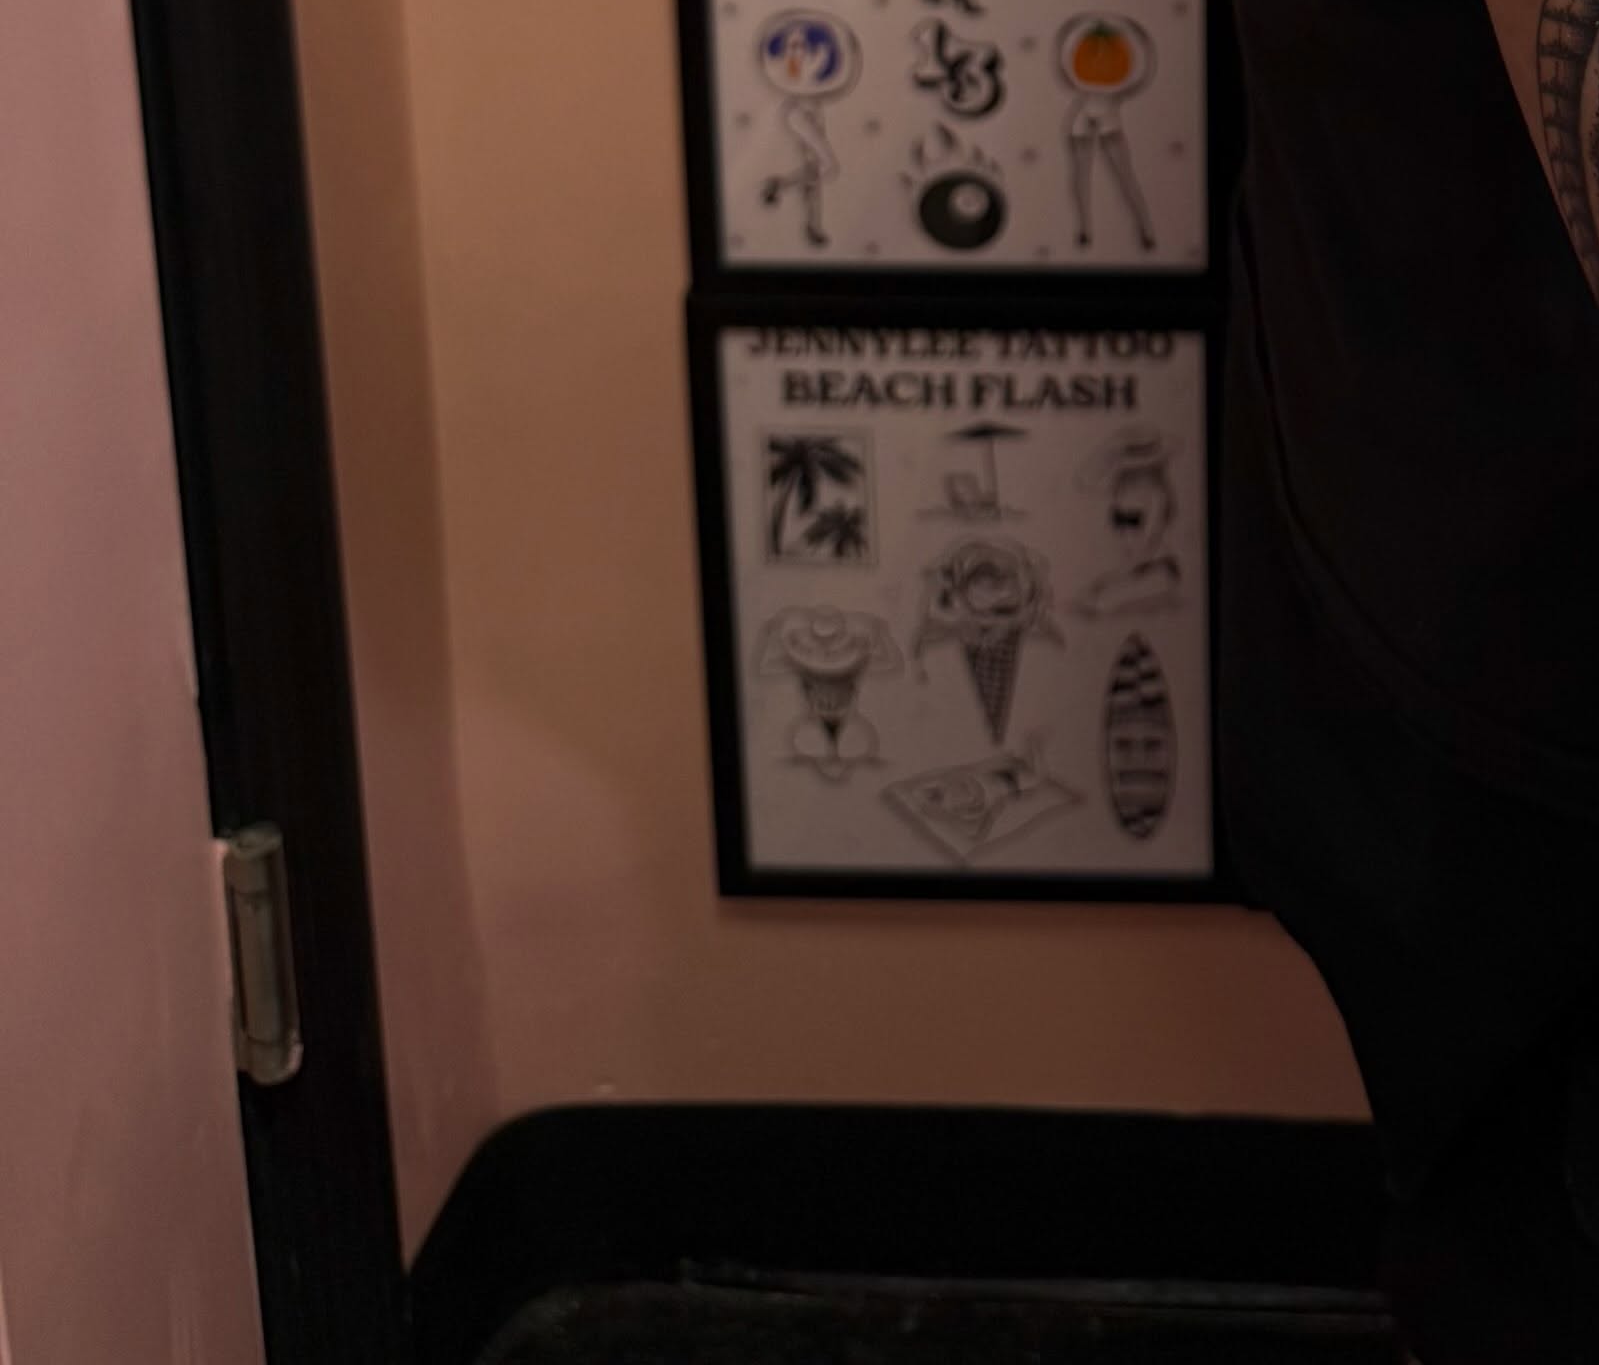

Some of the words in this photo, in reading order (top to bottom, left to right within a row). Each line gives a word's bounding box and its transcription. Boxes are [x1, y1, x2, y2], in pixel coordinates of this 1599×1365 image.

[748, 328, 981, 359] JENNYLEE
[999, 330, 1176, 361] TATTOO
[782, 371, 957, 408] BEACH
[967, 373, 1139, 409] FLASH
